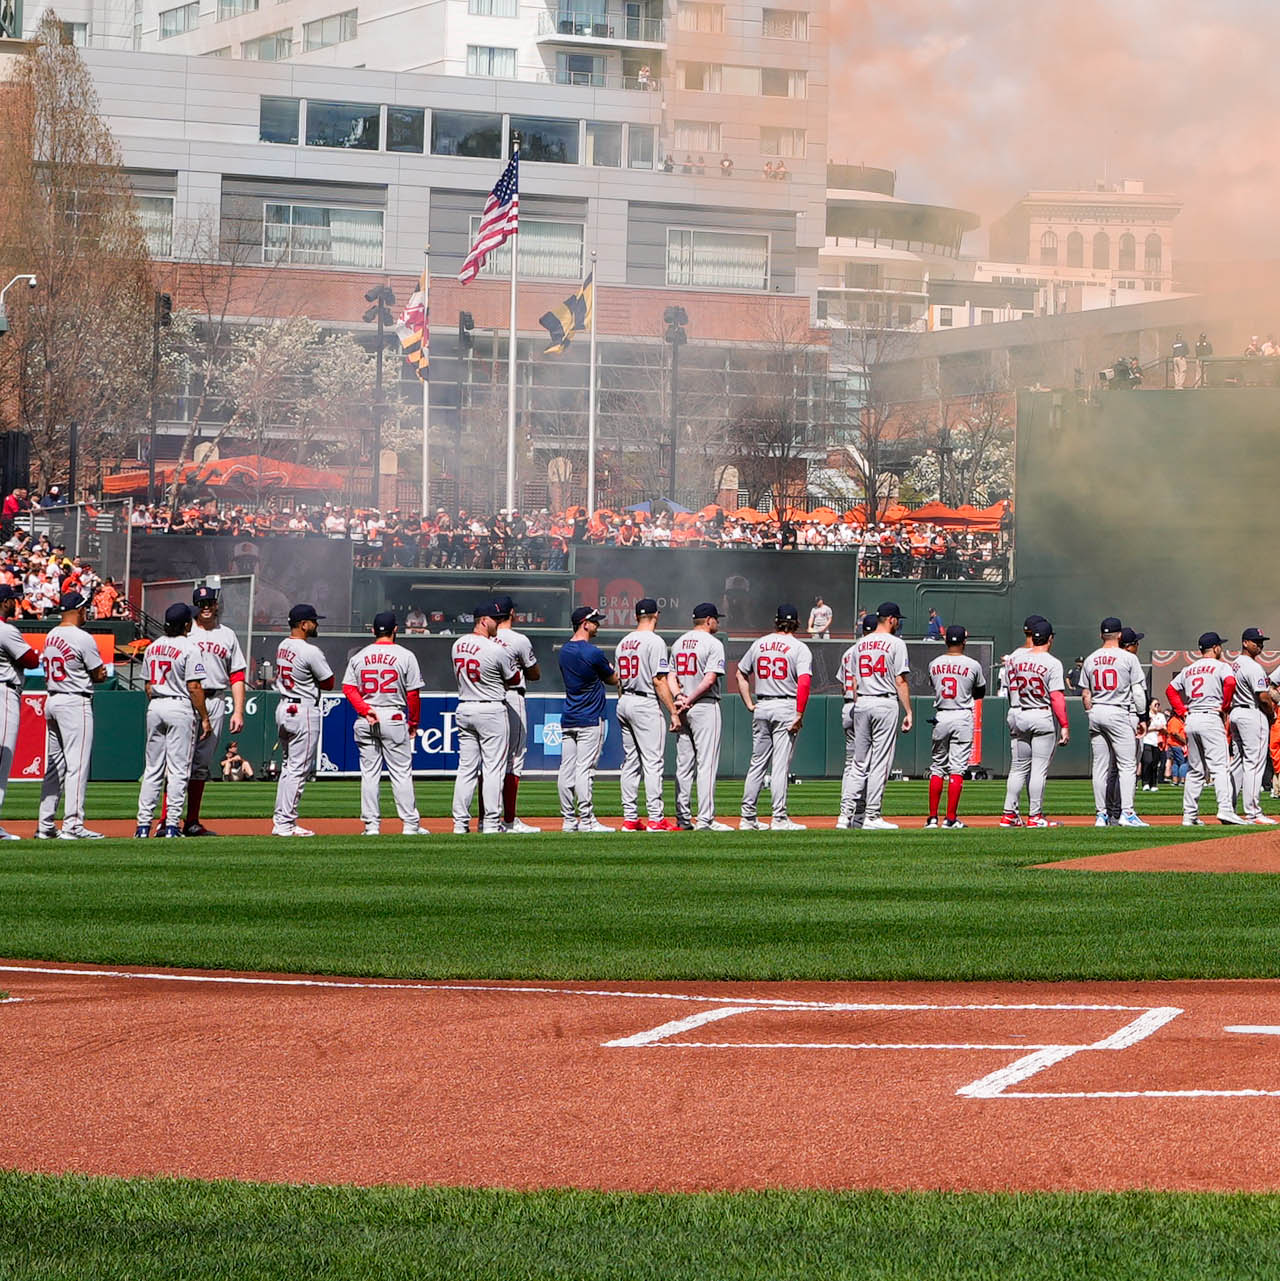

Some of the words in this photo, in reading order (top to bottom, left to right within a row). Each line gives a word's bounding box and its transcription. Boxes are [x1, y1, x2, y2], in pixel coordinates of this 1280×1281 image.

[600, 595, 680, 609] BRANON
[456, 642, 481, 656] KELLY
[858, 637, 891, 654] CRISWELL
[364, 654, 398, 667] ABREU
[454, 658, 481, 684] 76
[675, 653, 698, 677] 80
[757, 656, 788, 681] 63
[858, 654, 888, 678] 64
[931, 663, 970, 677] RAFAELA
[1093, 656, 1118, 667] STORY
[149, 660, 173, 686] 17
[360, 669, 399, 695] 52
[1092, 669, 1118, 692] 10
[941, 676, 958, 700] 3
[1016, 676, 1046, 699] 23
[1191, 677, 1205, 699] 2
